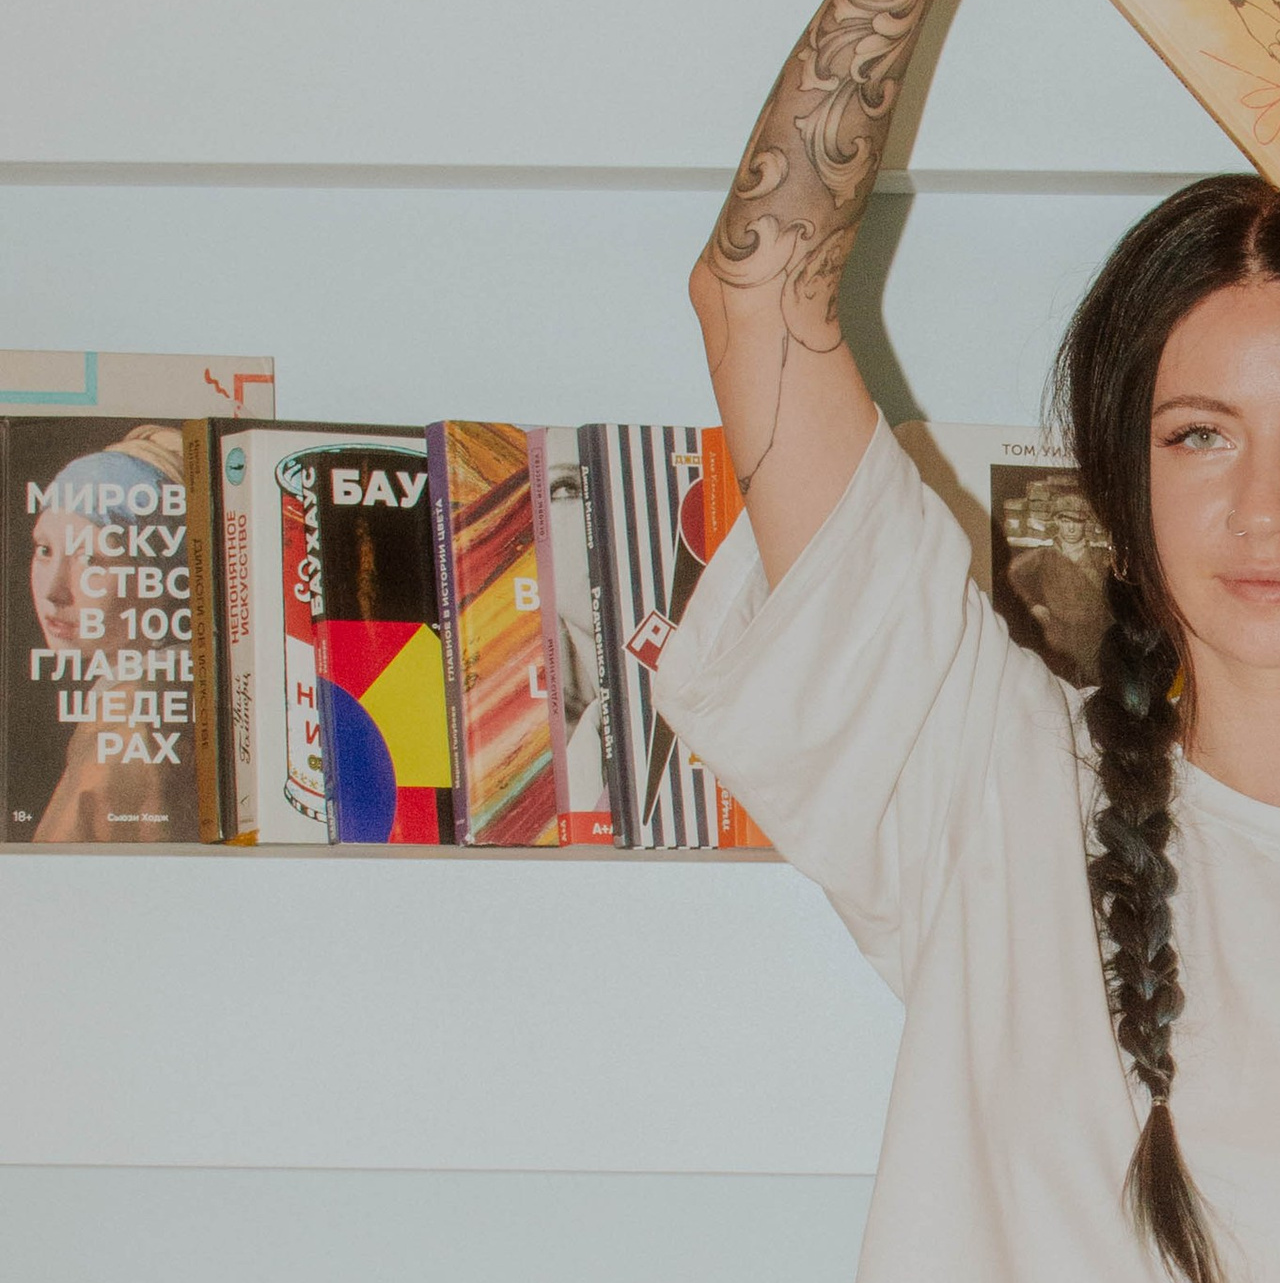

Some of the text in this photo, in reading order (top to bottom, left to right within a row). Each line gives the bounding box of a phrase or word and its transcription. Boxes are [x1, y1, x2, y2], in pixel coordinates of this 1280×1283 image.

[1002, 443, 1036, 456] ТОМ
[26, 481, 187, 516] МИРОВ
[330, 469, 427, 510] БАУ
[64, 524, 187, 558] ИСКУ
[301, 465, 326, 616] БАУХАУС
[227, 510, 240, 645] НЕПОНЯТНОЕ
[237, 514, 249, 637] ИСКУССТВО
[434, 498, 455, 682] ГЛАВНОЕ ИСТОРИИ ЦВЕТА
[79, 608, 106, 640] В
[548, 638, 560, 716] ХУДОЖНИЦЫ
[57, 690, 196, 729] ШЕДЕ
[599, 687, 613, 760] Дизайн
[96, 732, 182, 765] РАХ
[12, 810, 33, 823] 18+
